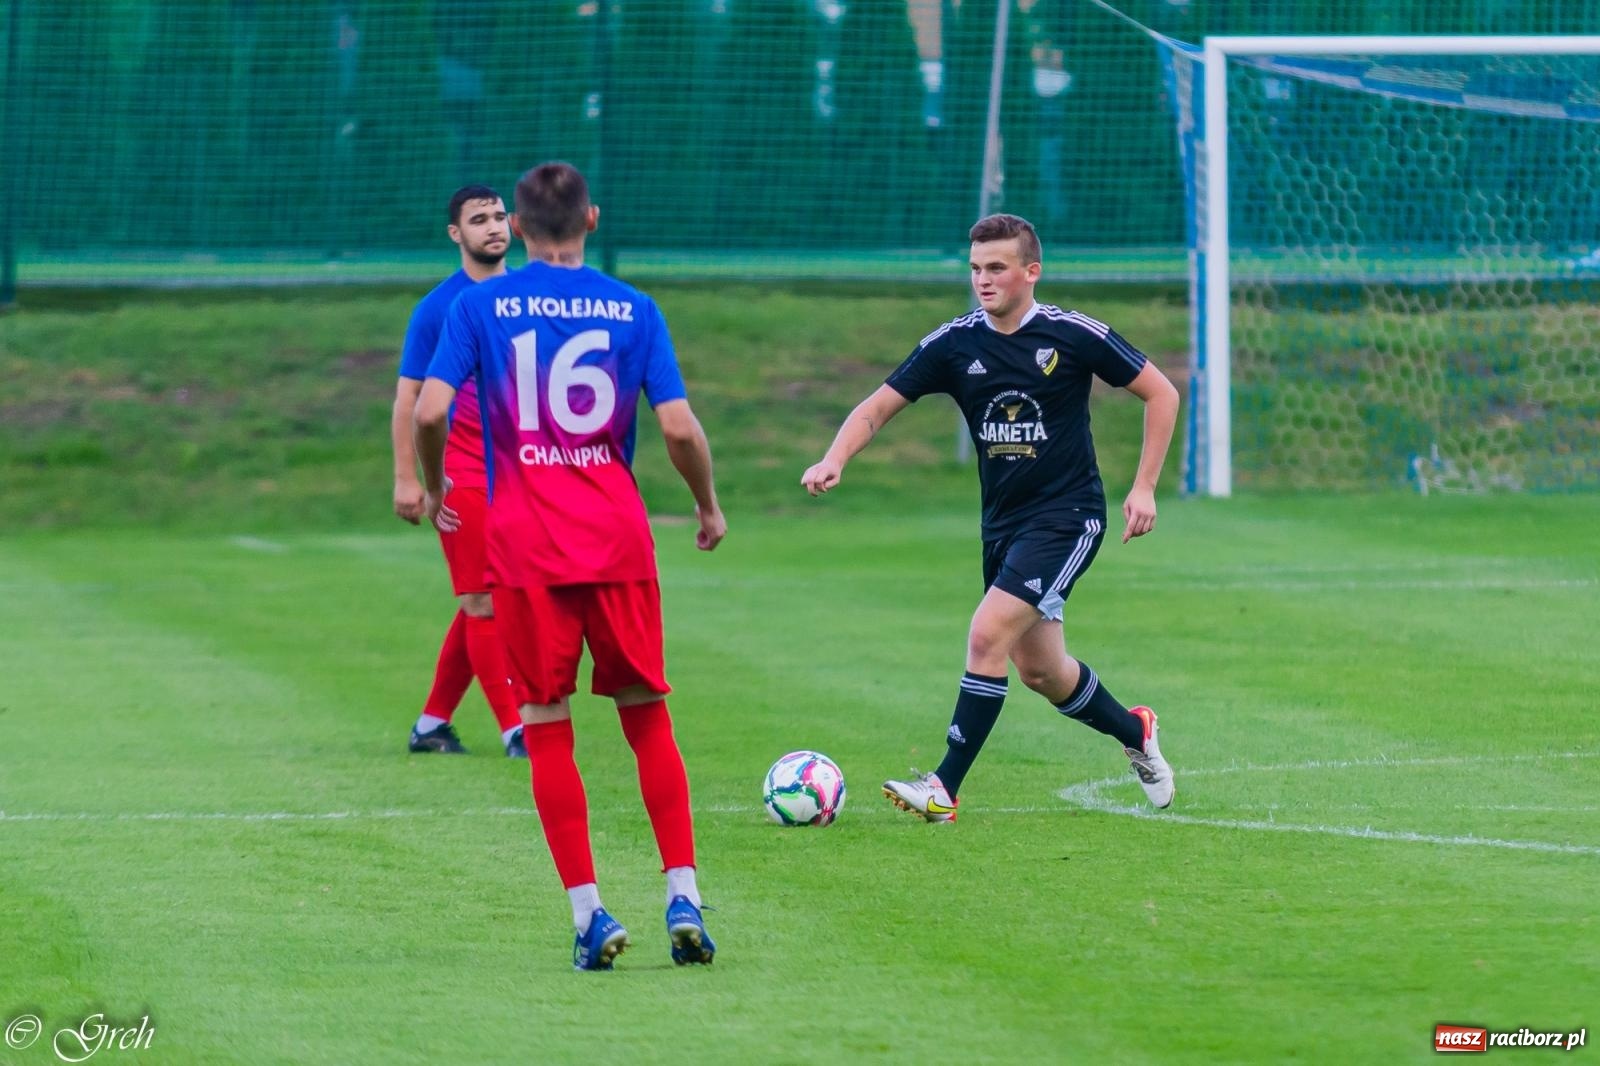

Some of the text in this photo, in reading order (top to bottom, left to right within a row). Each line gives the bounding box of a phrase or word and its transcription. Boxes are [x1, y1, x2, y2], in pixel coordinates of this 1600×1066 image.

[495, 296, 633, 322] KS KOLEJARZ
[511, 328, 616, 435] 16
[979, 421, 1048, 442] JANETA
